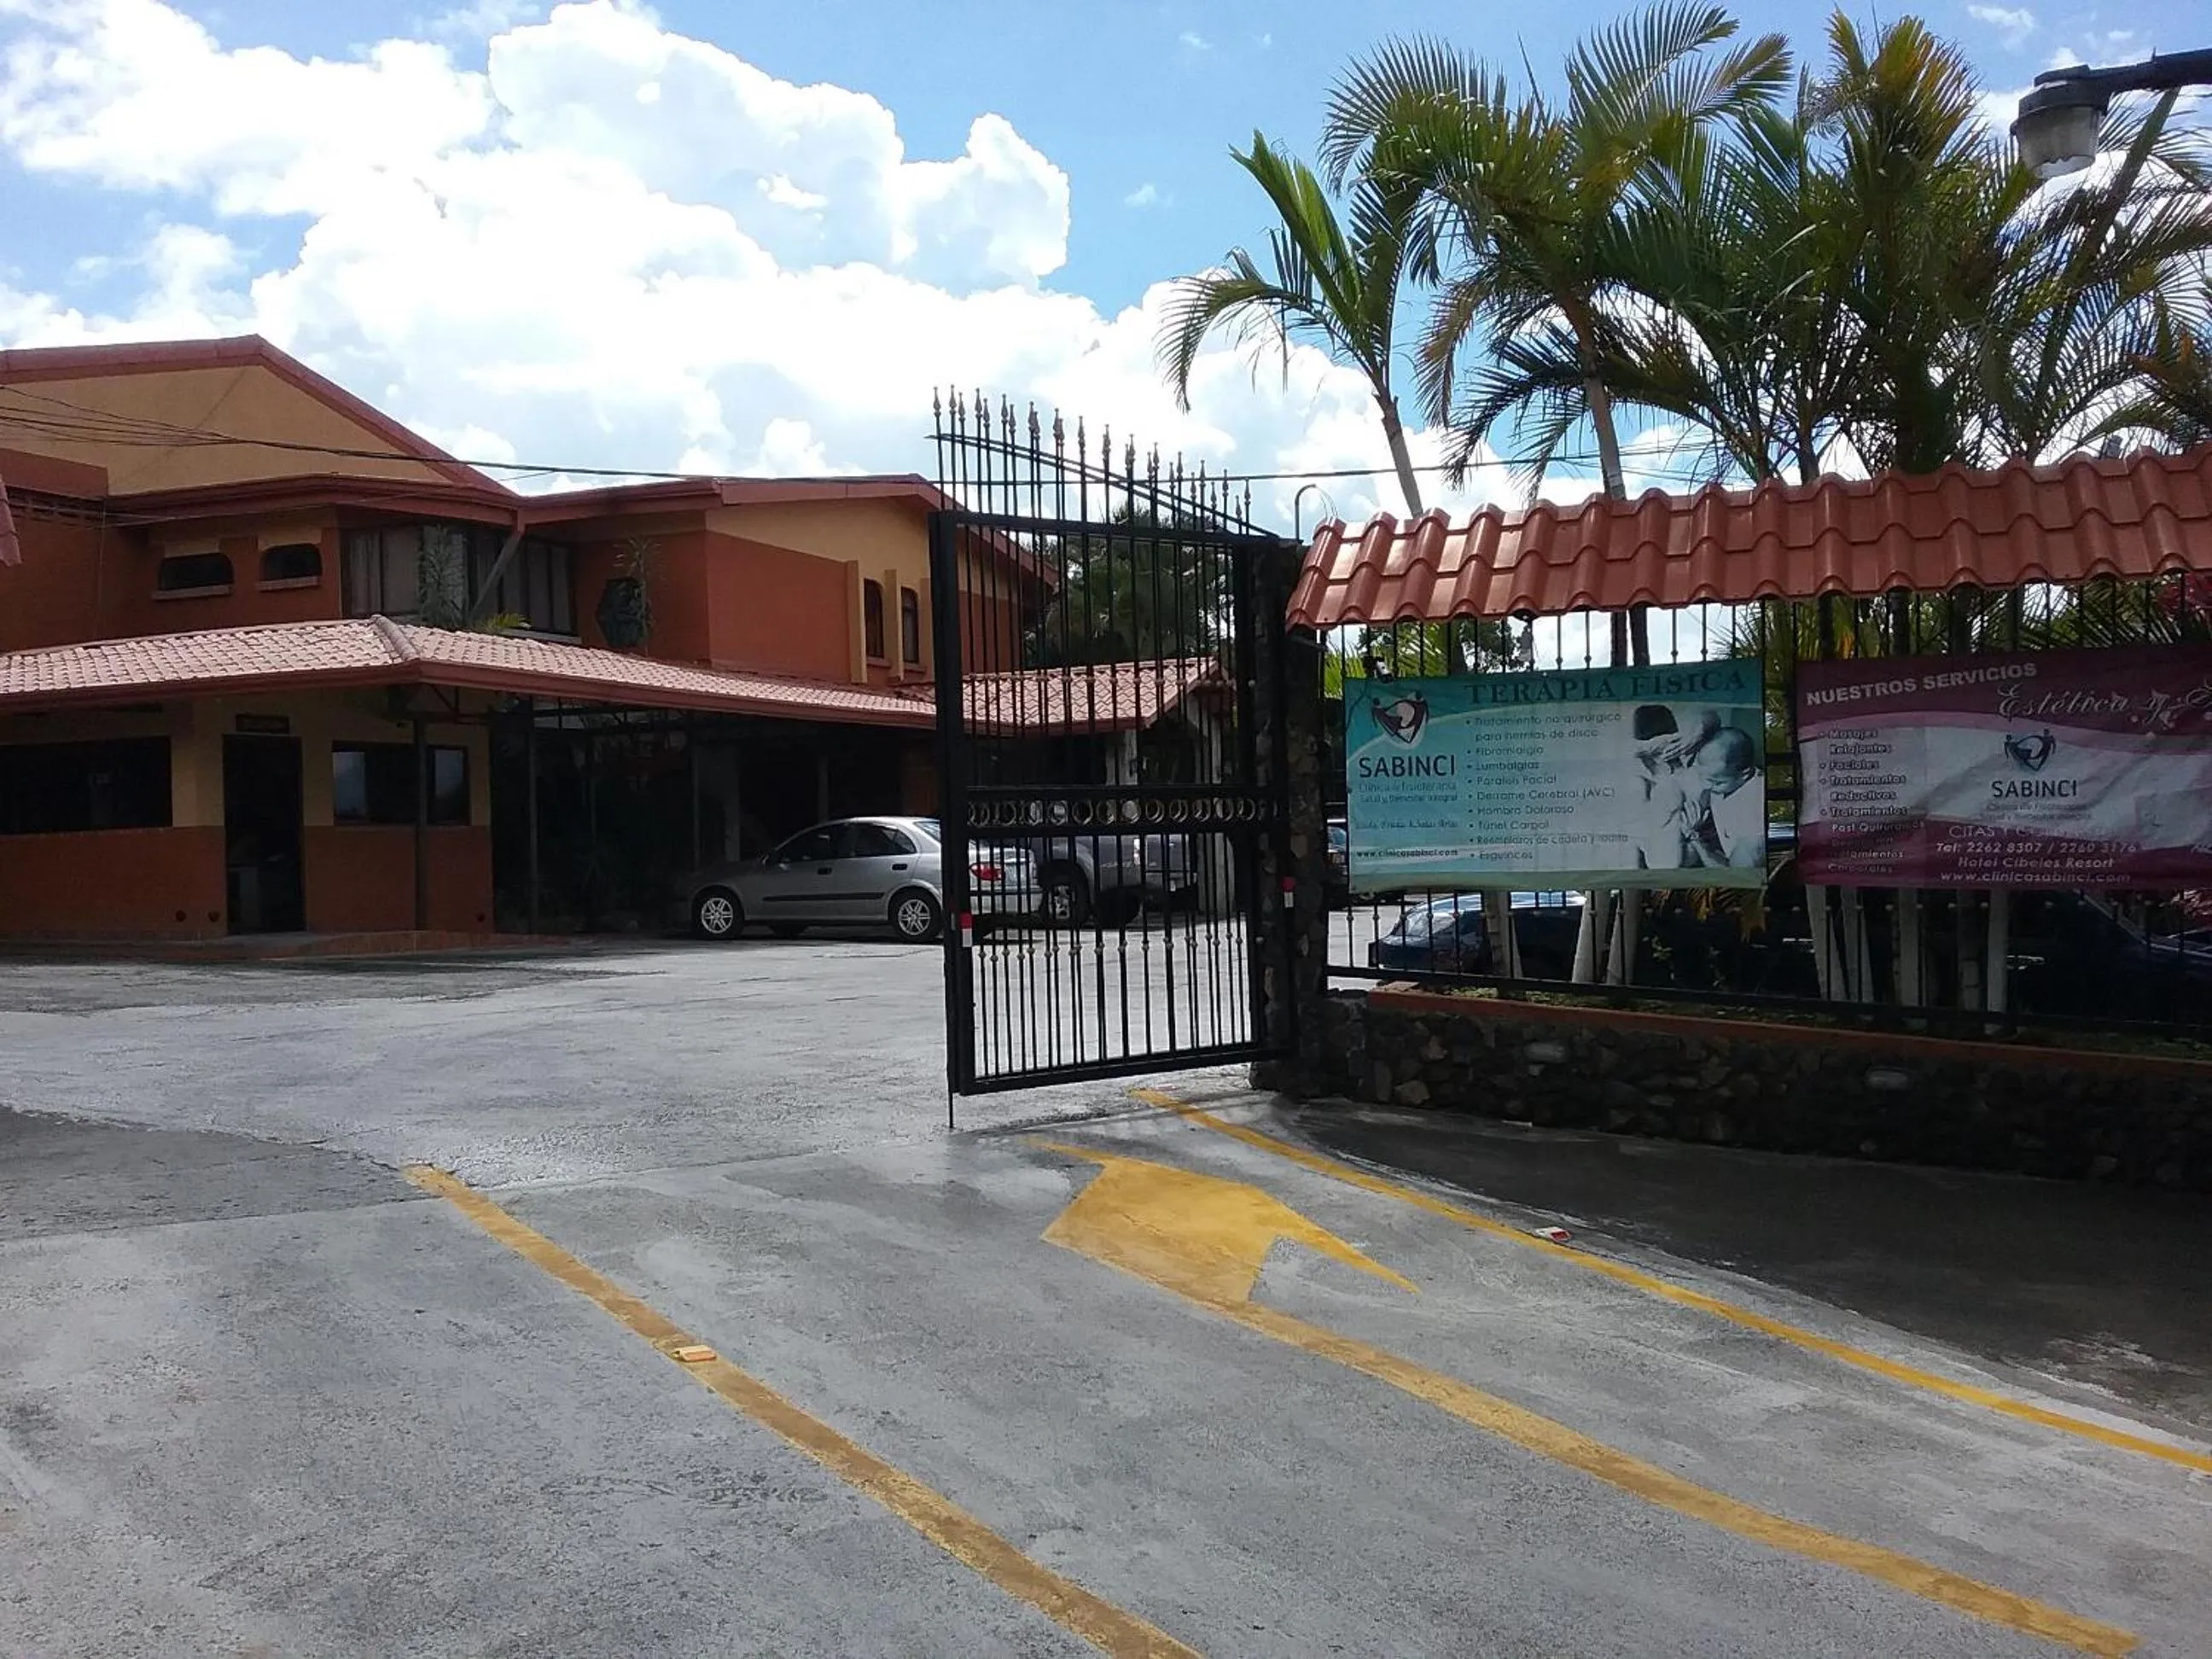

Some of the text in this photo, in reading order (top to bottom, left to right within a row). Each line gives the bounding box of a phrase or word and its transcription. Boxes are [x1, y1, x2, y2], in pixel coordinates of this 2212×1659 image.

[1464, 678, 1618, 705] TERAPIA
[1805, 662, 2037, 707] NUESTROS SERVICIOS
[1359, 754, 1456, 777] SABINCI
[1528, 789, 1579, 800] Cerebral
[1991, 779, 2078, 798] SABINCI
[1966, 841, 2003, 853] 2262
[2006, 841, 2042, 853] 8307
[1958, 856, 2115, 869] Hotel Cibeles Resort
